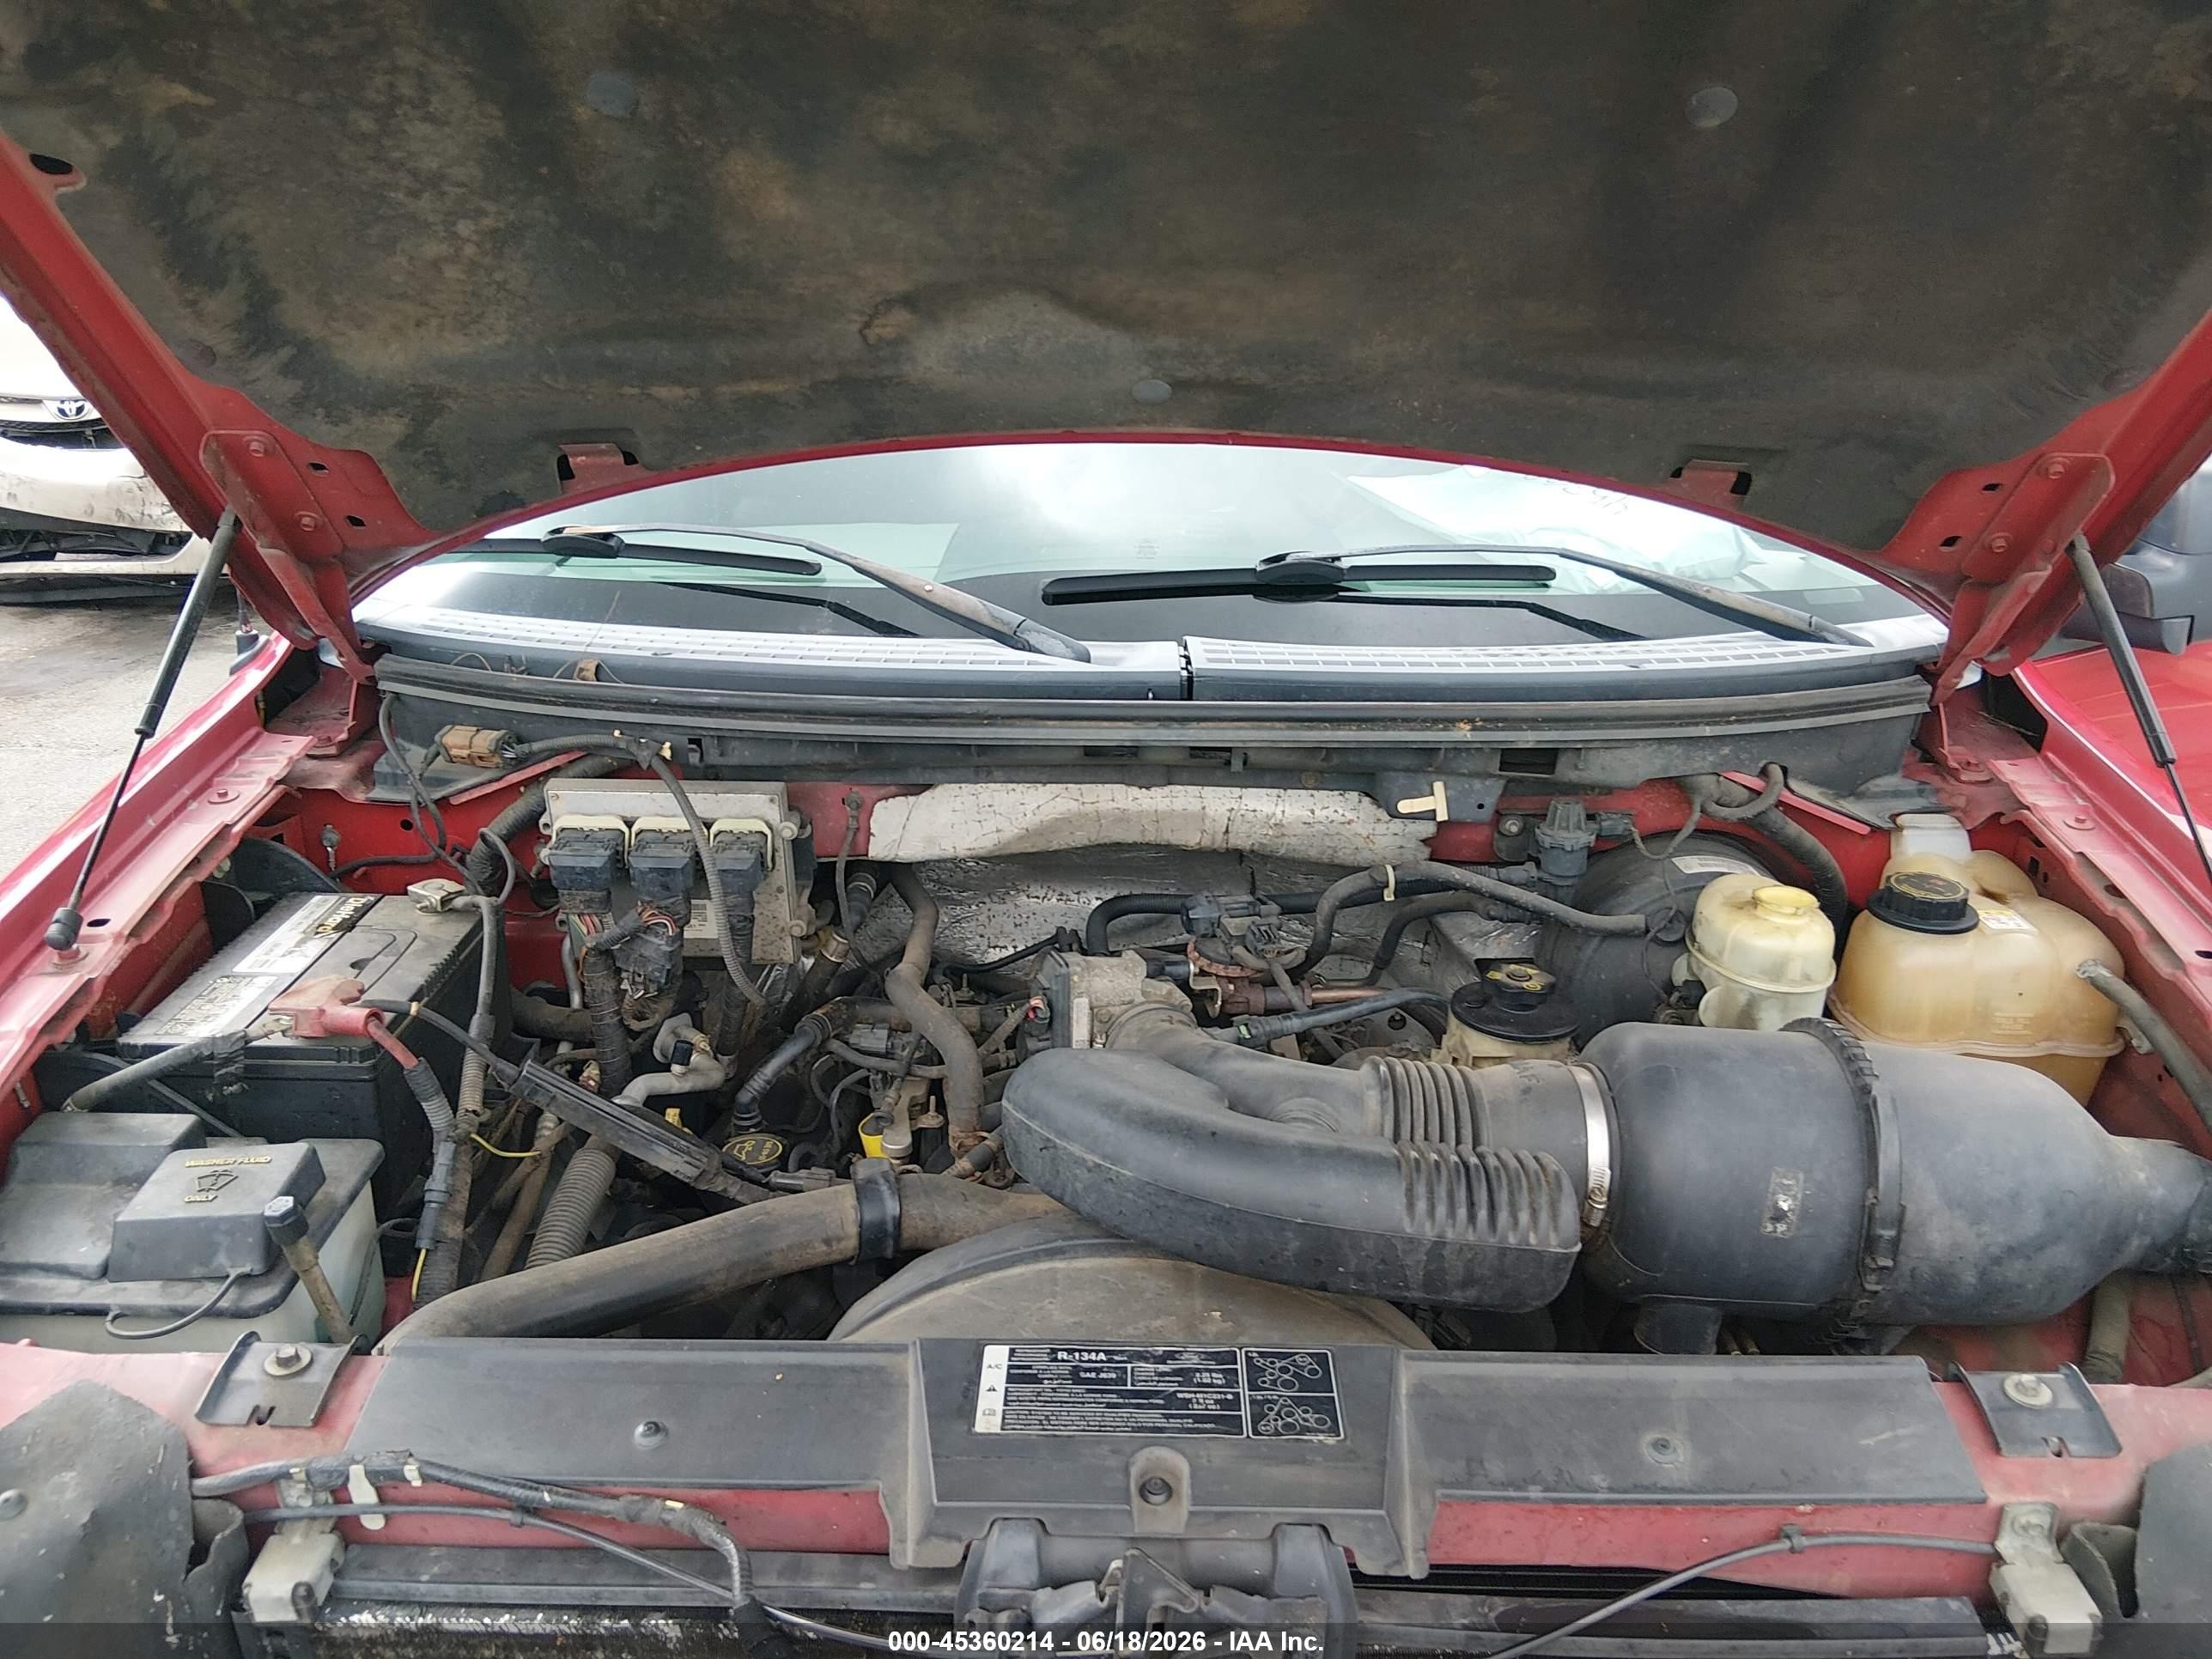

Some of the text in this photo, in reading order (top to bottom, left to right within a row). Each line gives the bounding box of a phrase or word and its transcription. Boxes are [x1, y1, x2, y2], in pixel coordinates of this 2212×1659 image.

[317, 896, 367, 933] DieHard
[185, 1156, 272, 1168] WASHER FLUID
[184, 1194, 218, 1203] ONLY
[1057, 1351, 1108, 1361] R-134A
